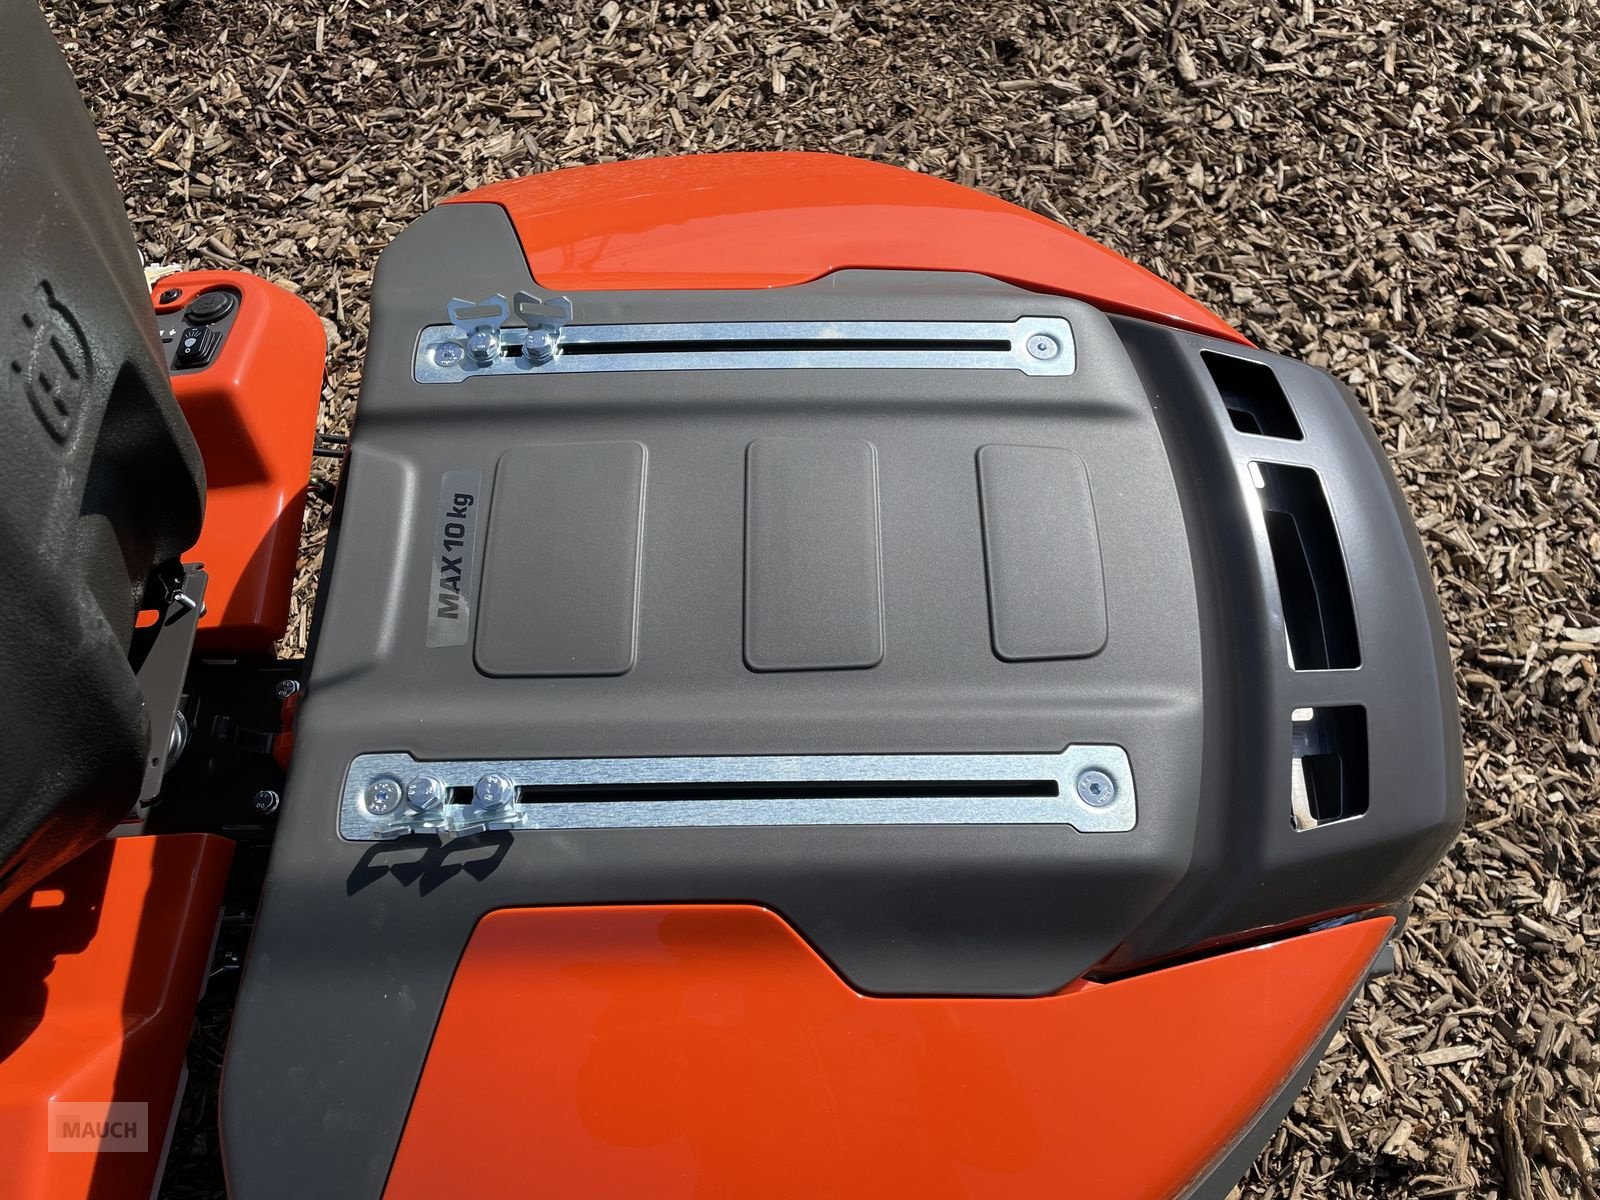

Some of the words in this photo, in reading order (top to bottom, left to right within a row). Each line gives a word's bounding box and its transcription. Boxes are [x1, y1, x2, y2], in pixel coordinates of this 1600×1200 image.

[446, 493, 474, 519] kg
[443, 523, 466, 552] 10
[437, 556, 463, 620] MAX
